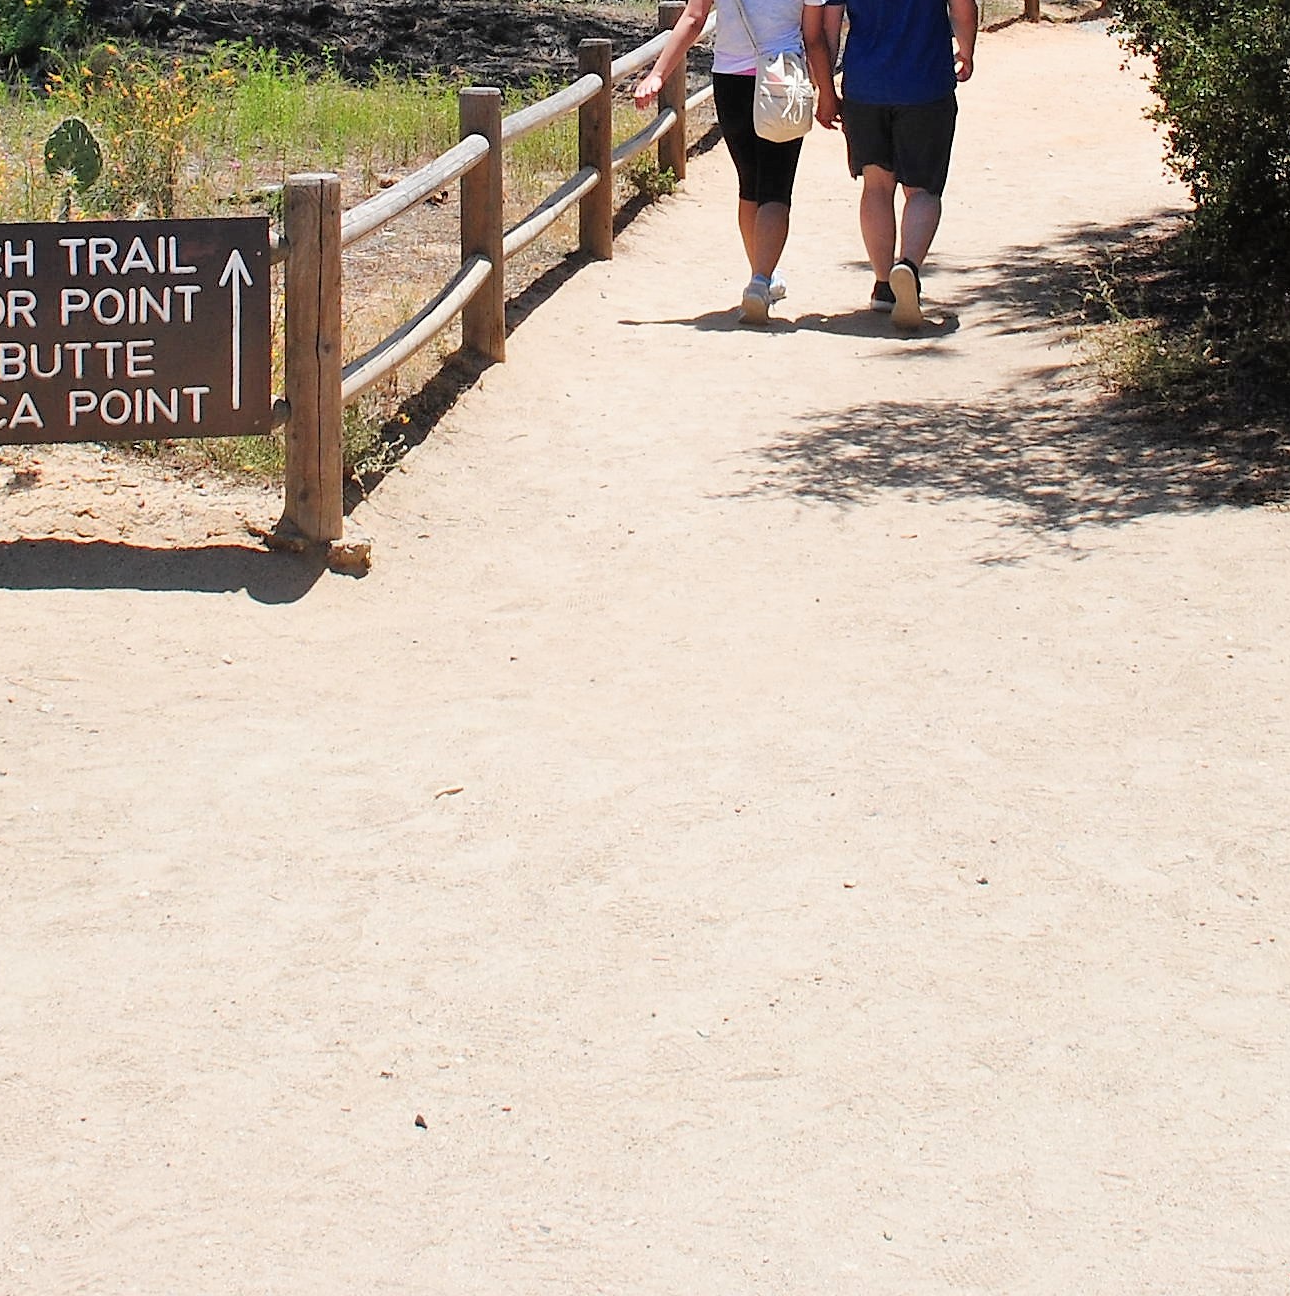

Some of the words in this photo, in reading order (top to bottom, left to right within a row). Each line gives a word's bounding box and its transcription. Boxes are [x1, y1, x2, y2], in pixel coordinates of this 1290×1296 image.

[58, 235, 198, 277] TRAIL
[59, 284, 203, 327] POINT
[68, 386, 210, 427] POINT
